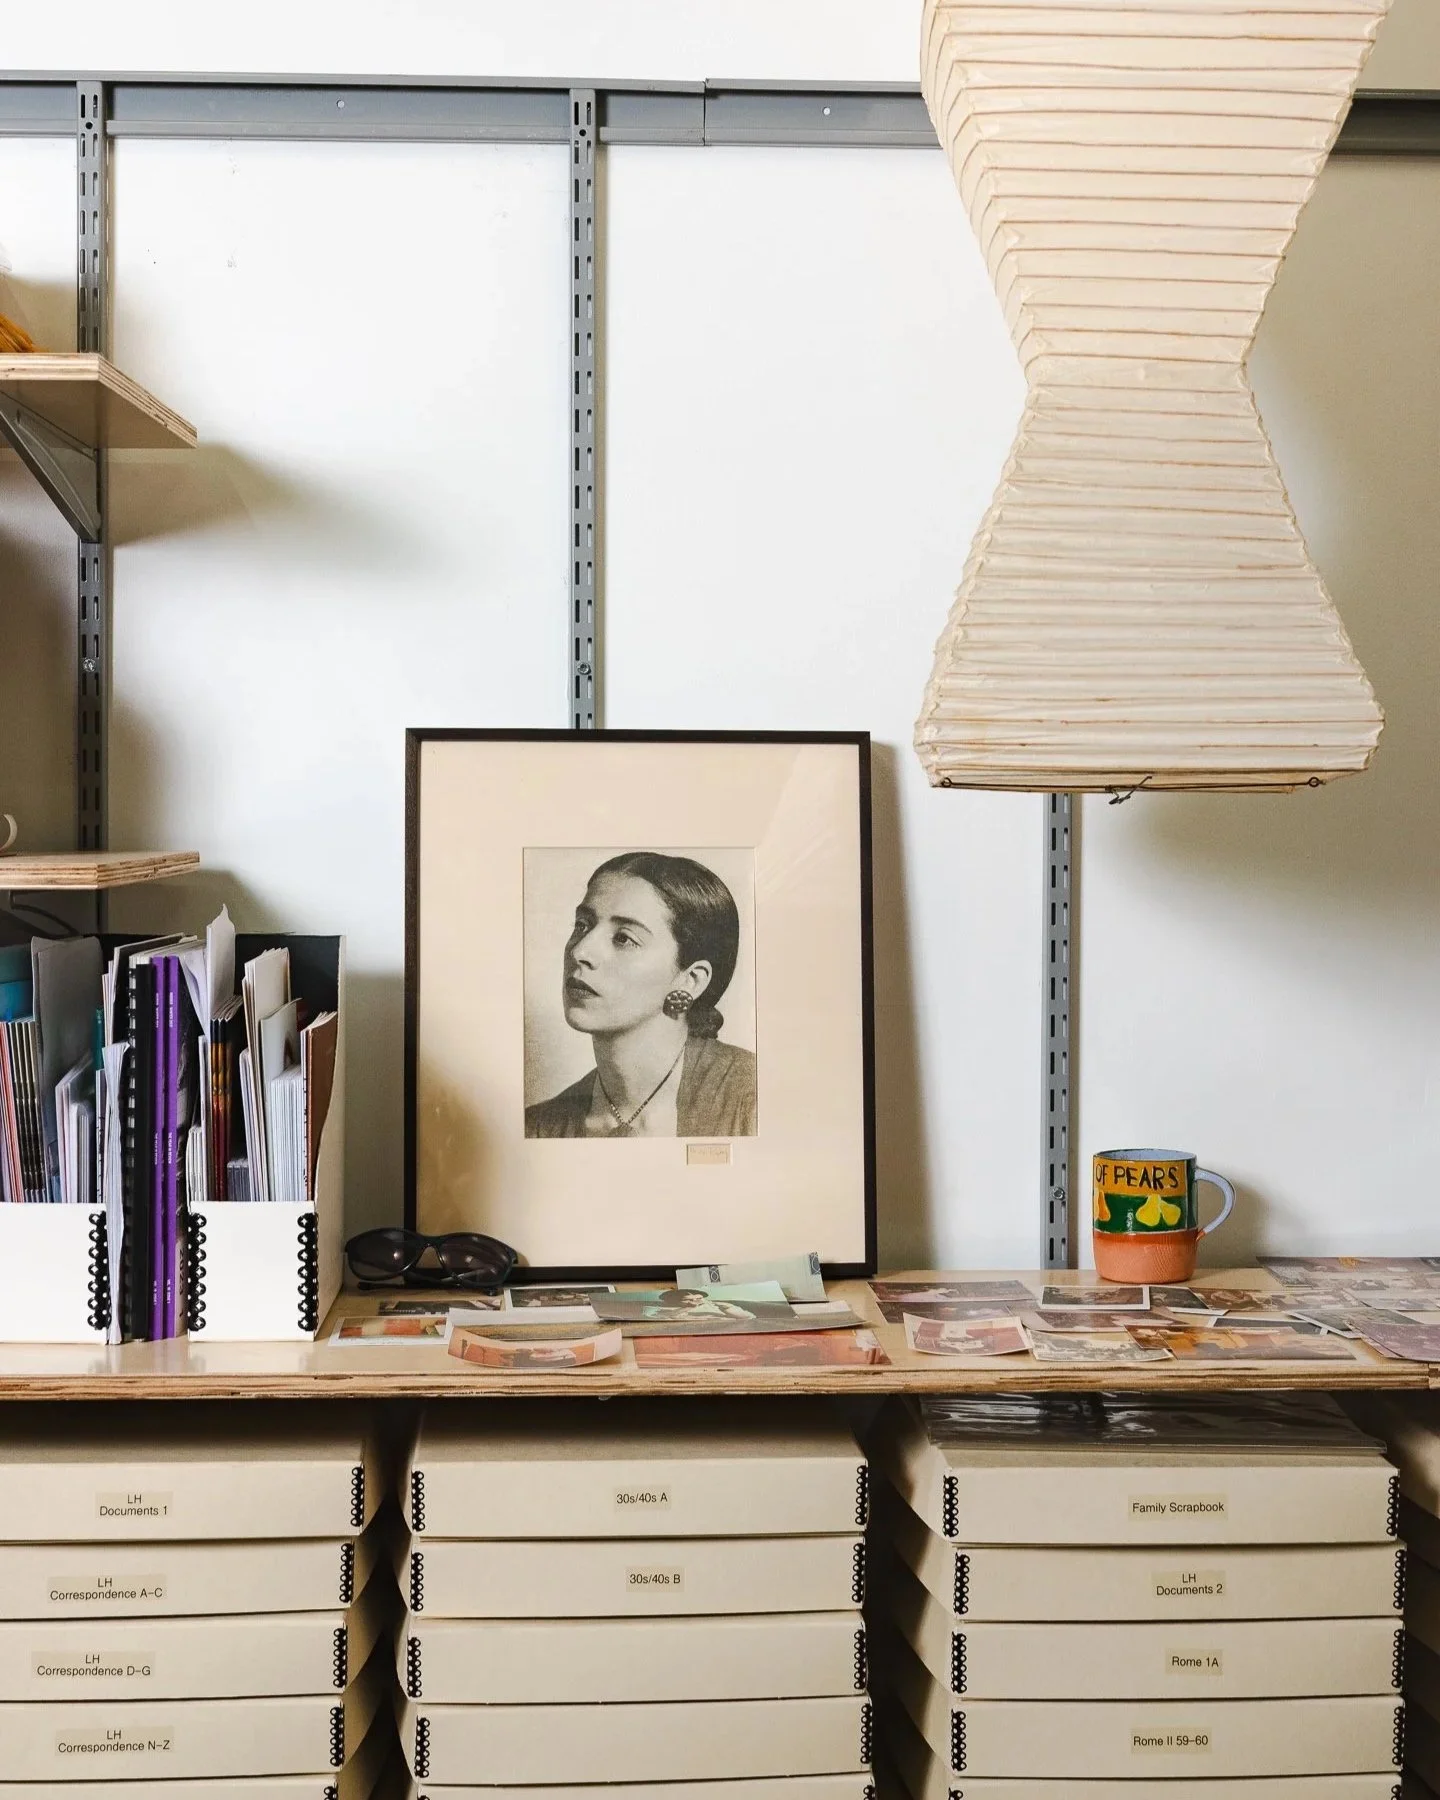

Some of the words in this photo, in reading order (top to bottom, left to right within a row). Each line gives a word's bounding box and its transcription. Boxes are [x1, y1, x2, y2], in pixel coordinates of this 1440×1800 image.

[1095, 1164, 1108, 1186] OF
[1113, 1165, 1180, 1190] PEARS
[127, 1493, 142, 1504] LH
[616, 1492, 657, 1504] 30s/40s
[660, 1491, 668, 1502] A
[99, 1504, 159, 1517] Documents
[163, 1505, 168, 1516] 1
[1132, 1502, 1167, 1515] Family
[1169, 1501, 1225, 1515] Scrapbook
[97, 1577, 113, 1588] LH
[629, 1573, 670, 1585] 30s/40s
[673, 1573, 681, 1584] B
[1182, 1572, 1197, 1583] LH
[49, 1588, 137, 1602] Correspondence
[1156, 1583, 1214, 1596] Documents
[1216, 1583, 1223, 1594] 2
[85, 1653, 100, 1664] LH
[1171, 1656, 1203, 1668] Rome
[1205, 1656, 1220, 1668] 1A
[36, 1665, 124, 1678] Correspondence
[106, 1729, 122, 1741] LH
[1133, 1735, 1164, 1747] Rome
[1166, 1735, 1173, 1746] II
[58, 1741, 145, 1754] Correspondence
